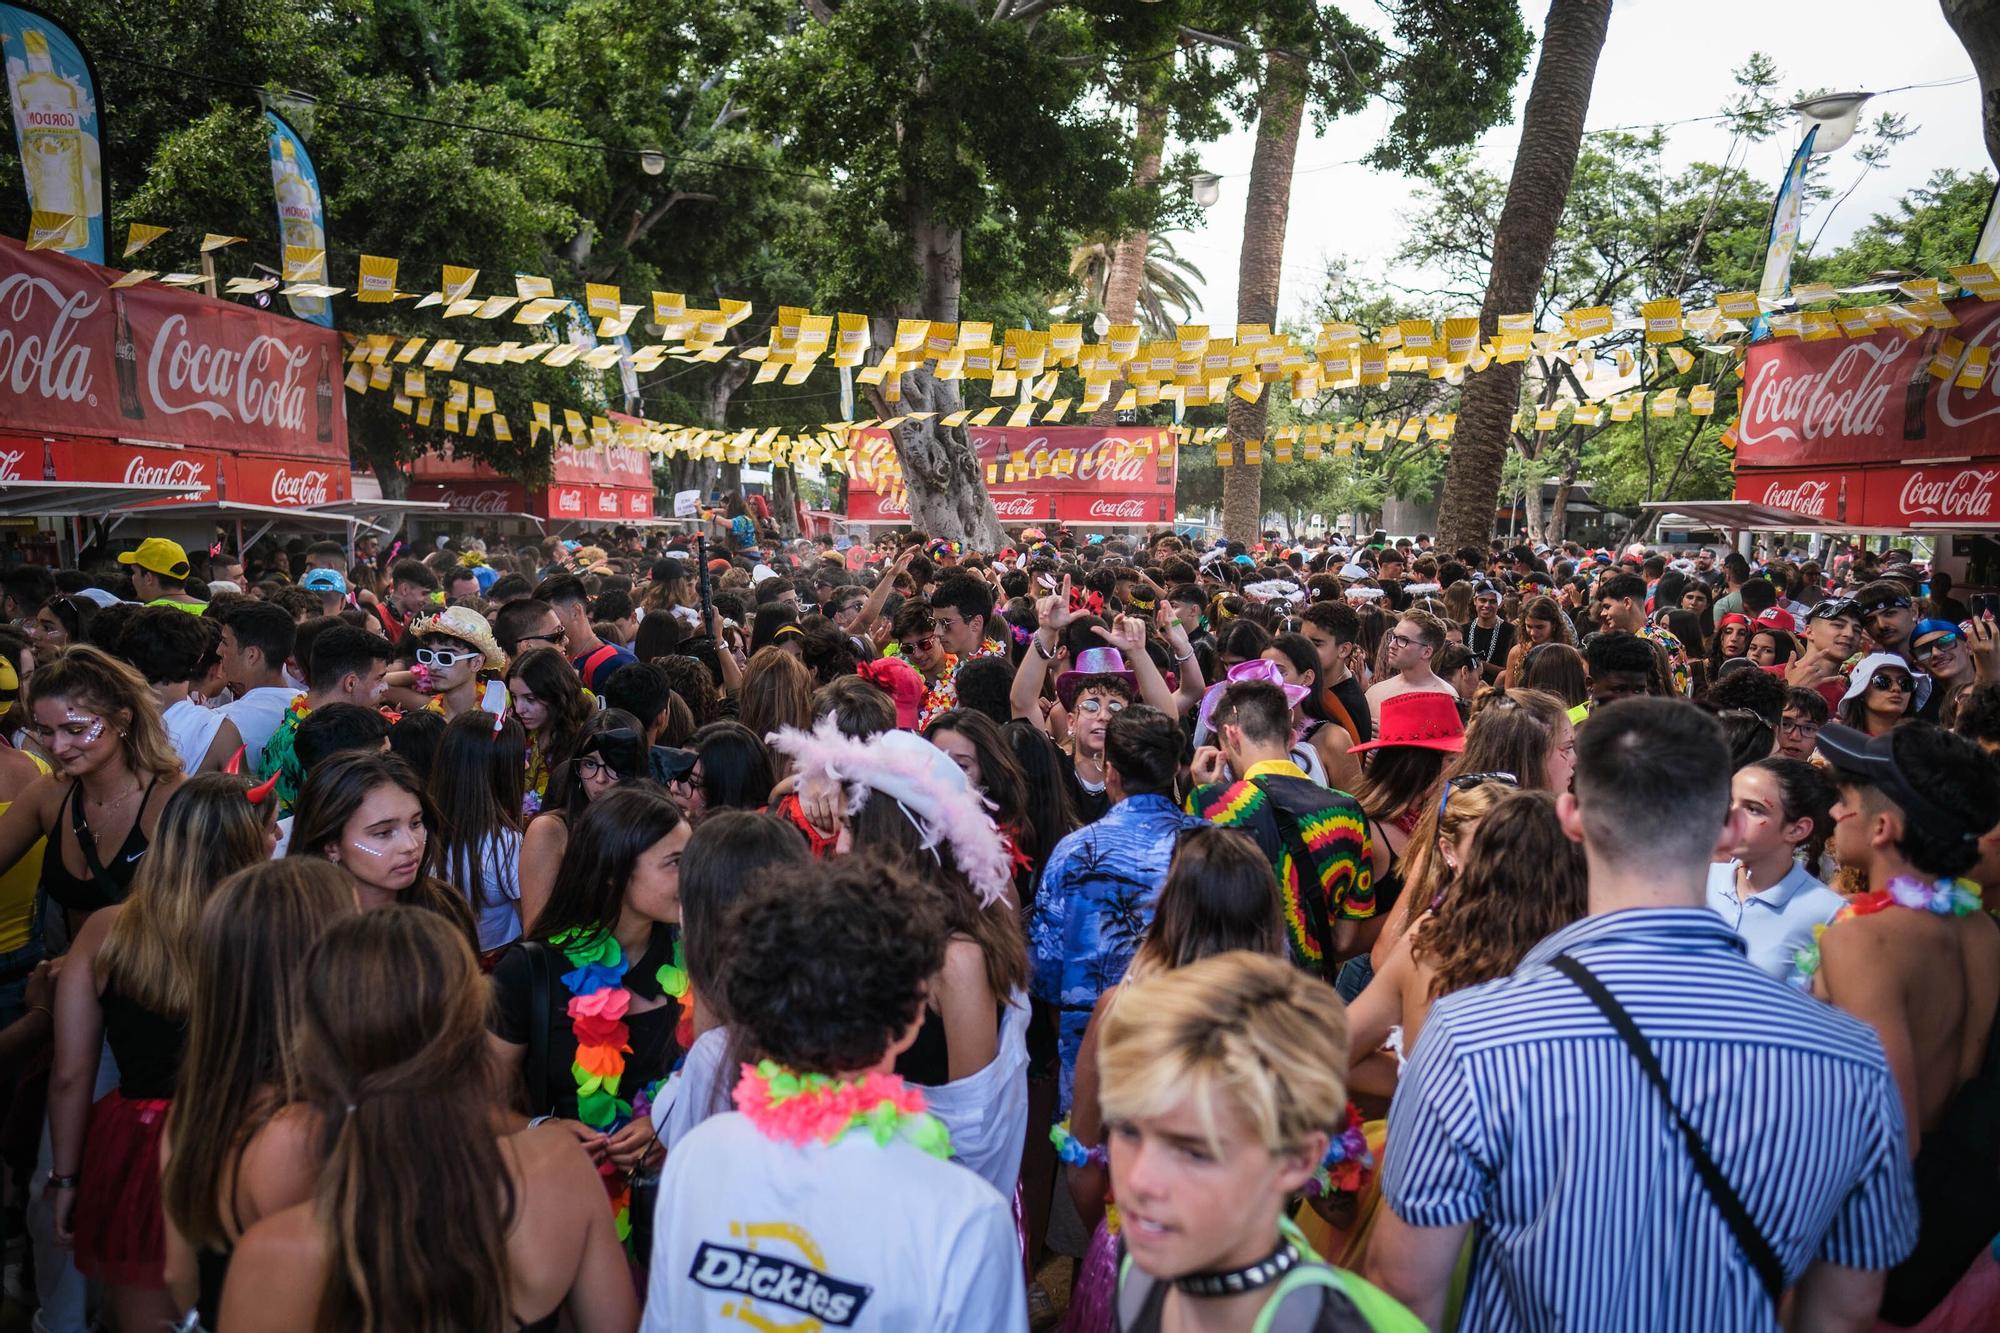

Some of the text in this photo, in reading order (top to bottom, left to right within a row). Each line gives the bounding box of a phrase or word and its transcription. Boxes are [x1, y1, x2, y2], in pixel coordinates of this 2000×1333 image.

[148, 314, 313, 430] Coca-Cola
[1739, 337, 1909, 445] Coca-Cola
[271, 468, 330, 505] Coca-Cola
[1089, 499, 1148, 518] Coca-Cola
[1762, 480, 1830, 516] Coca-Cola
[1899, 469, 2000, 517] Coca-Cola
[696, 1247, 857, 1324] Dickies
